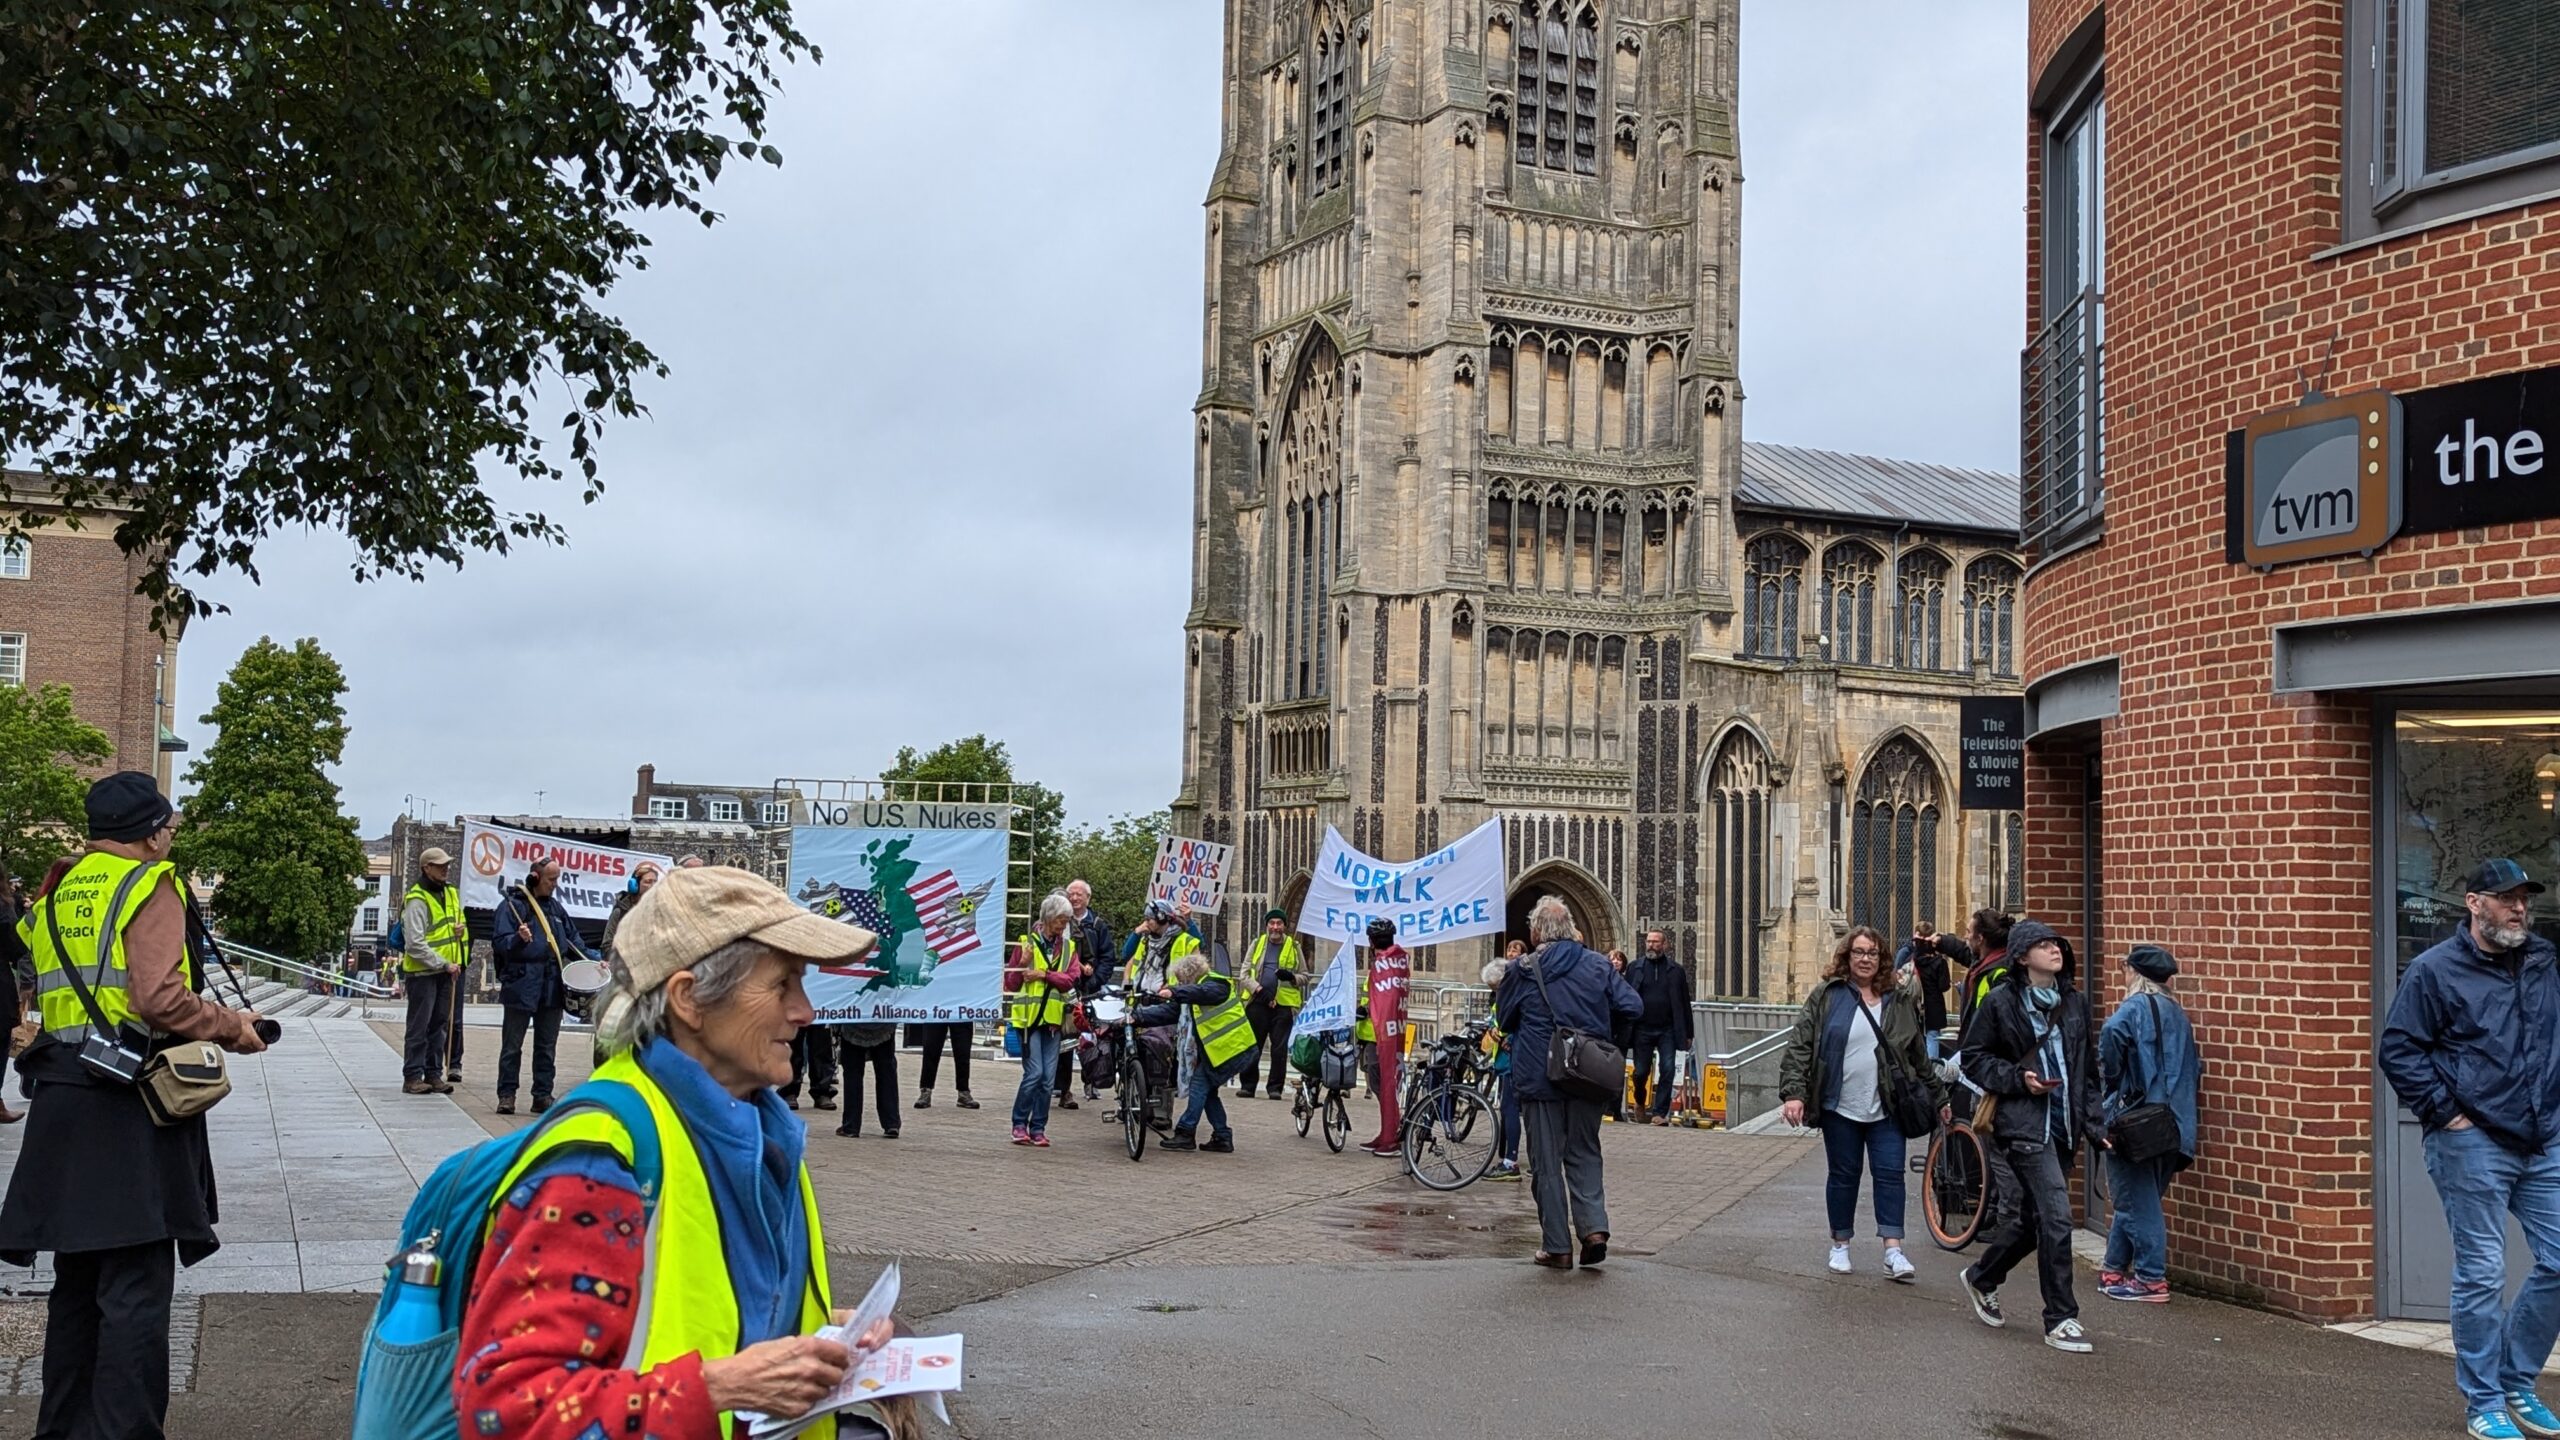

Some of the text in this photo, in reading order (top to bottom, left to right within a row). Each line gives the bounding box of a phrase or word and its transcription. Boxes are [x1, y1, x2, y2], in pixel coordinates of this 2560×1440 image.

[2434, 418, 2544, 485] the
[2271, 488, 2353, 535] tvm
[1982, 718, 2005, 732] The
[1968, 755, 2019, 769] & Movie
[1976, 773, 2011, 788] Store
[812, 801, 996, 829] No U.S. Nukes
[512, 840, 626, 876] NO NUKES
[1160, 856, 1220, 879] US NUKES
[561, 872, 579, 885] AT
[1179, 875, 1200, 889] ON
[55, 889, 99, 905] Alliance
[1354, 875, 1435, 904] WALK
[1400, 898, 1490, 936] PEACE
[871, 1005, 927, 1019] Alliance
[933, 1006, 952, 1019] for
[958, 1006, 999, 1020] Peace
